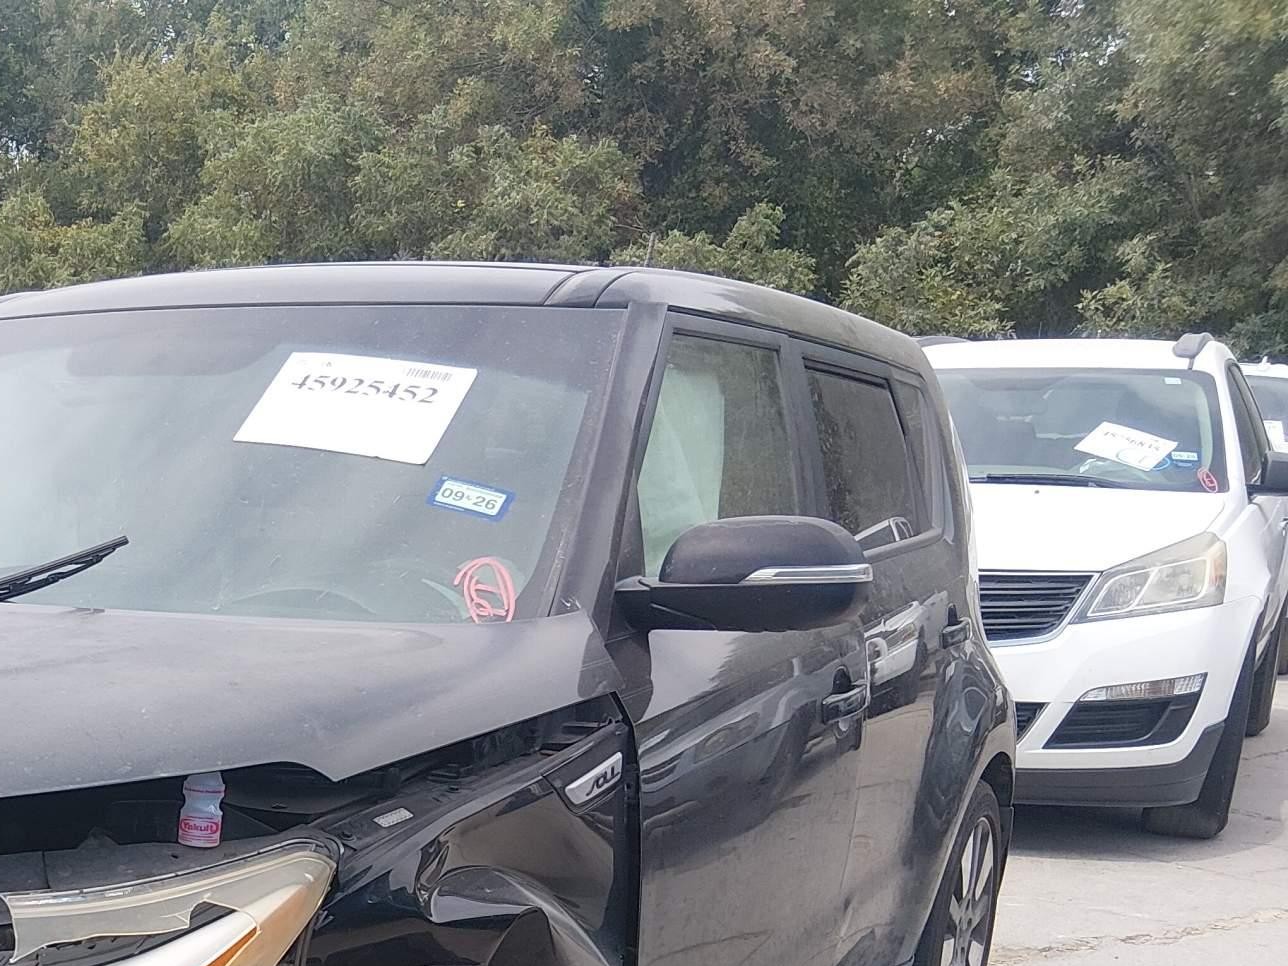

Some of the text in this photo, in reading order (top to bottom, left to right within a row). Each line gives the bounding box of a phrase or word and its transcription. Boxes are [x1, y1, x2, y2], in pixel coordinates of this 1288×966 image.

[291, 374, 438, 404] 45925452
[441, 487, 498, 510] 09 26
[183, 821, 214, 832] Yakult
